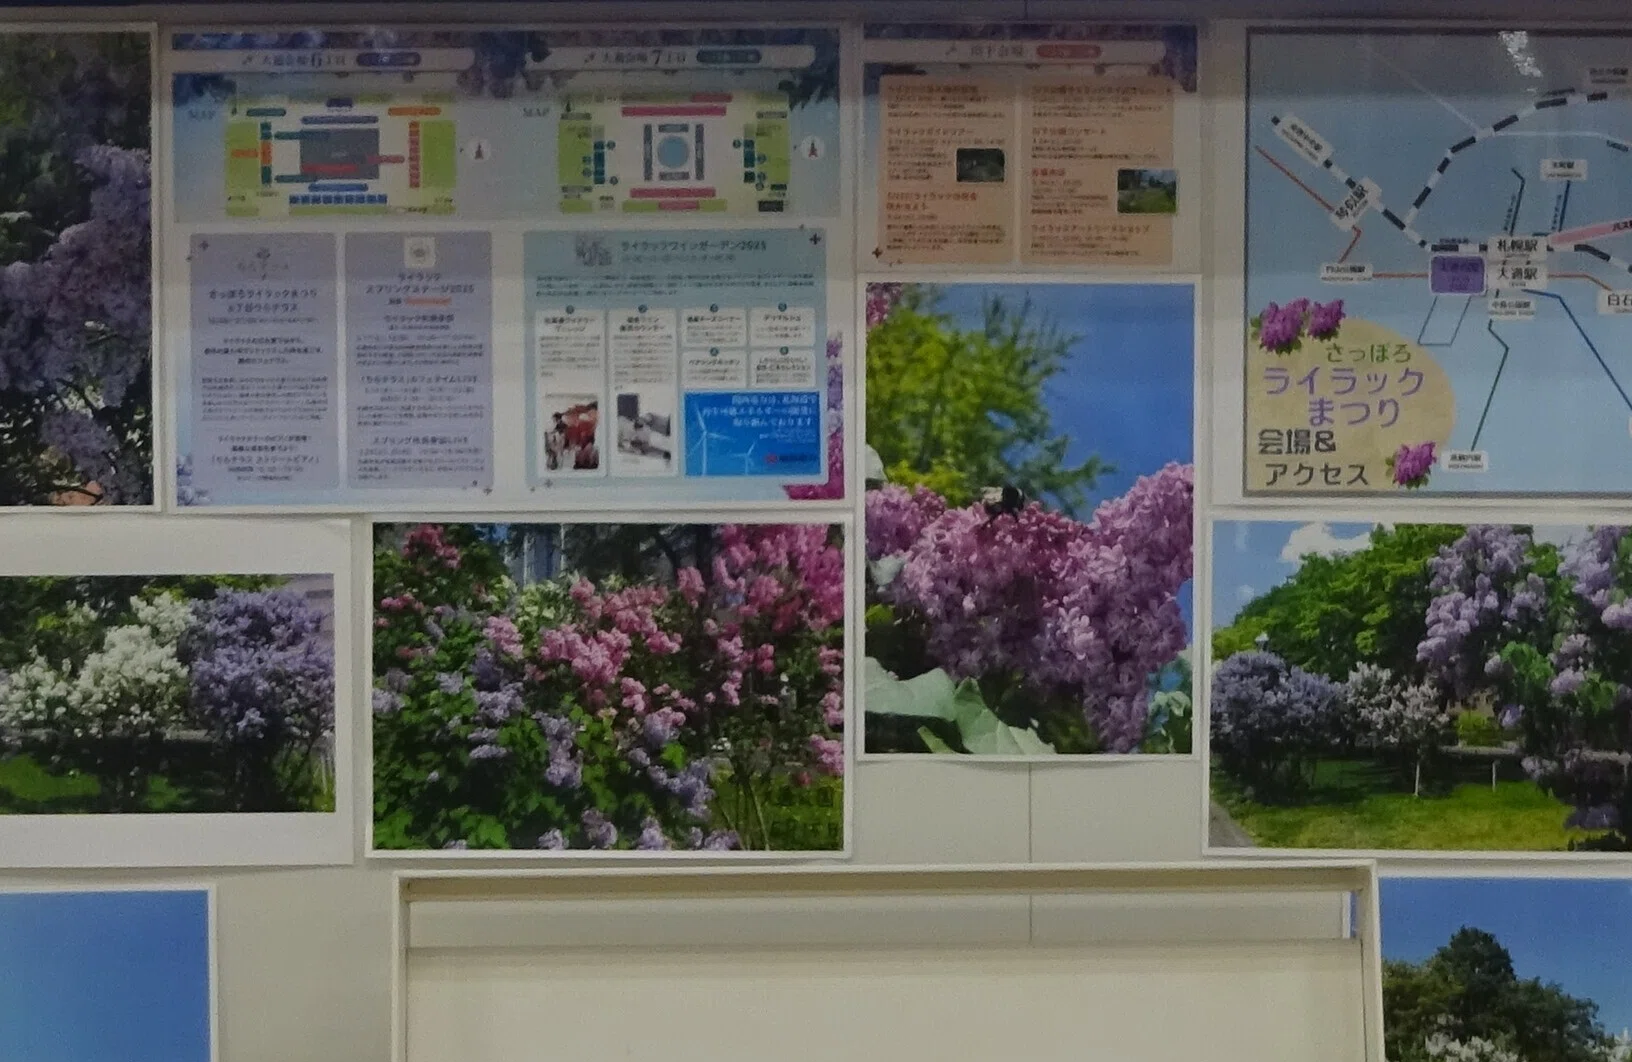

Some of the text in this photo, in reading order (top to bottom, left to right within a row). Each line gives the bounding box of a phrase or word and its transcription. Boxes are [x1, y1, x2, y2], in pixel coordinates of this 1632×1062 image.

[1497, 239, 1538, 251] 札幌駅
[1498, 264, 1538, 280] 大通駅
[1327, 344, 1411, 363] さっぽろ
[1263, 366, 1424, 396] ライラック
[1309, 397, 1400, 428] まつり
[1258, 428, 1336, 455] 会場&
[1265, 463, 1368, 486] アクセス
